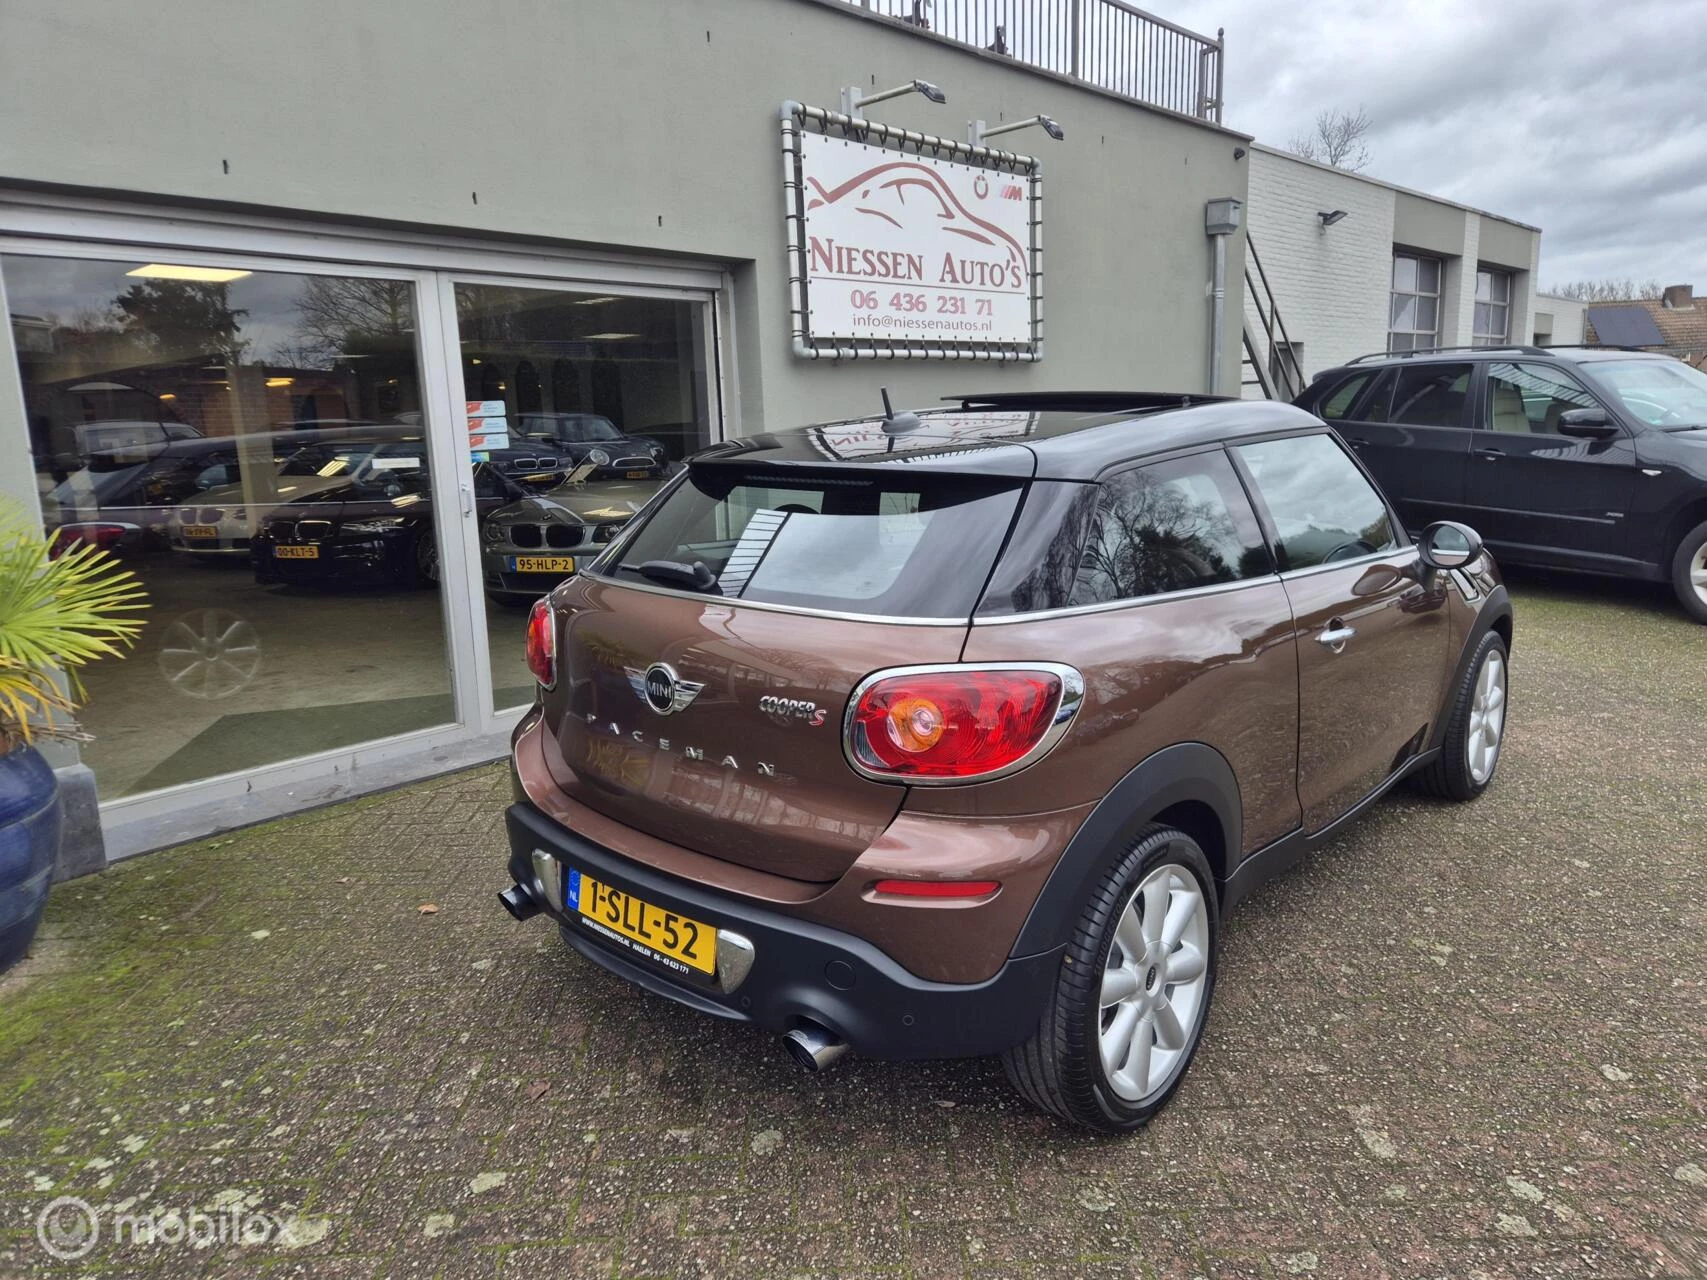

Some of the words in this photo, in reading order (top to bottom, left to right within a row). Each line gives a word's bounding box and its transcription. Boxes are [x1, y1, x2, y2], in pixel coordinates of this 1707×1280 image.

[809, 236, 923, 280] NIESSEN
[939, 252, 1022, 288] AUTO'S
[850, 289, 878, 311] 06
[889, 293, 927, 313] 436
[936, 296, 966, 315] 231
[975, 299, 993, 316] 71
[853, 313, 992, 332] info@niessenautos.nl
[519, 559, 569, 570] 95-HLP-2
[647, 683, 673, 700] MINI
[759, 695, 816, 719] COOPER
[808, 709, 828, 726] S
[569, 889, 579, 903] NL
[591, 881, 698, 960] 1-SLL-52
